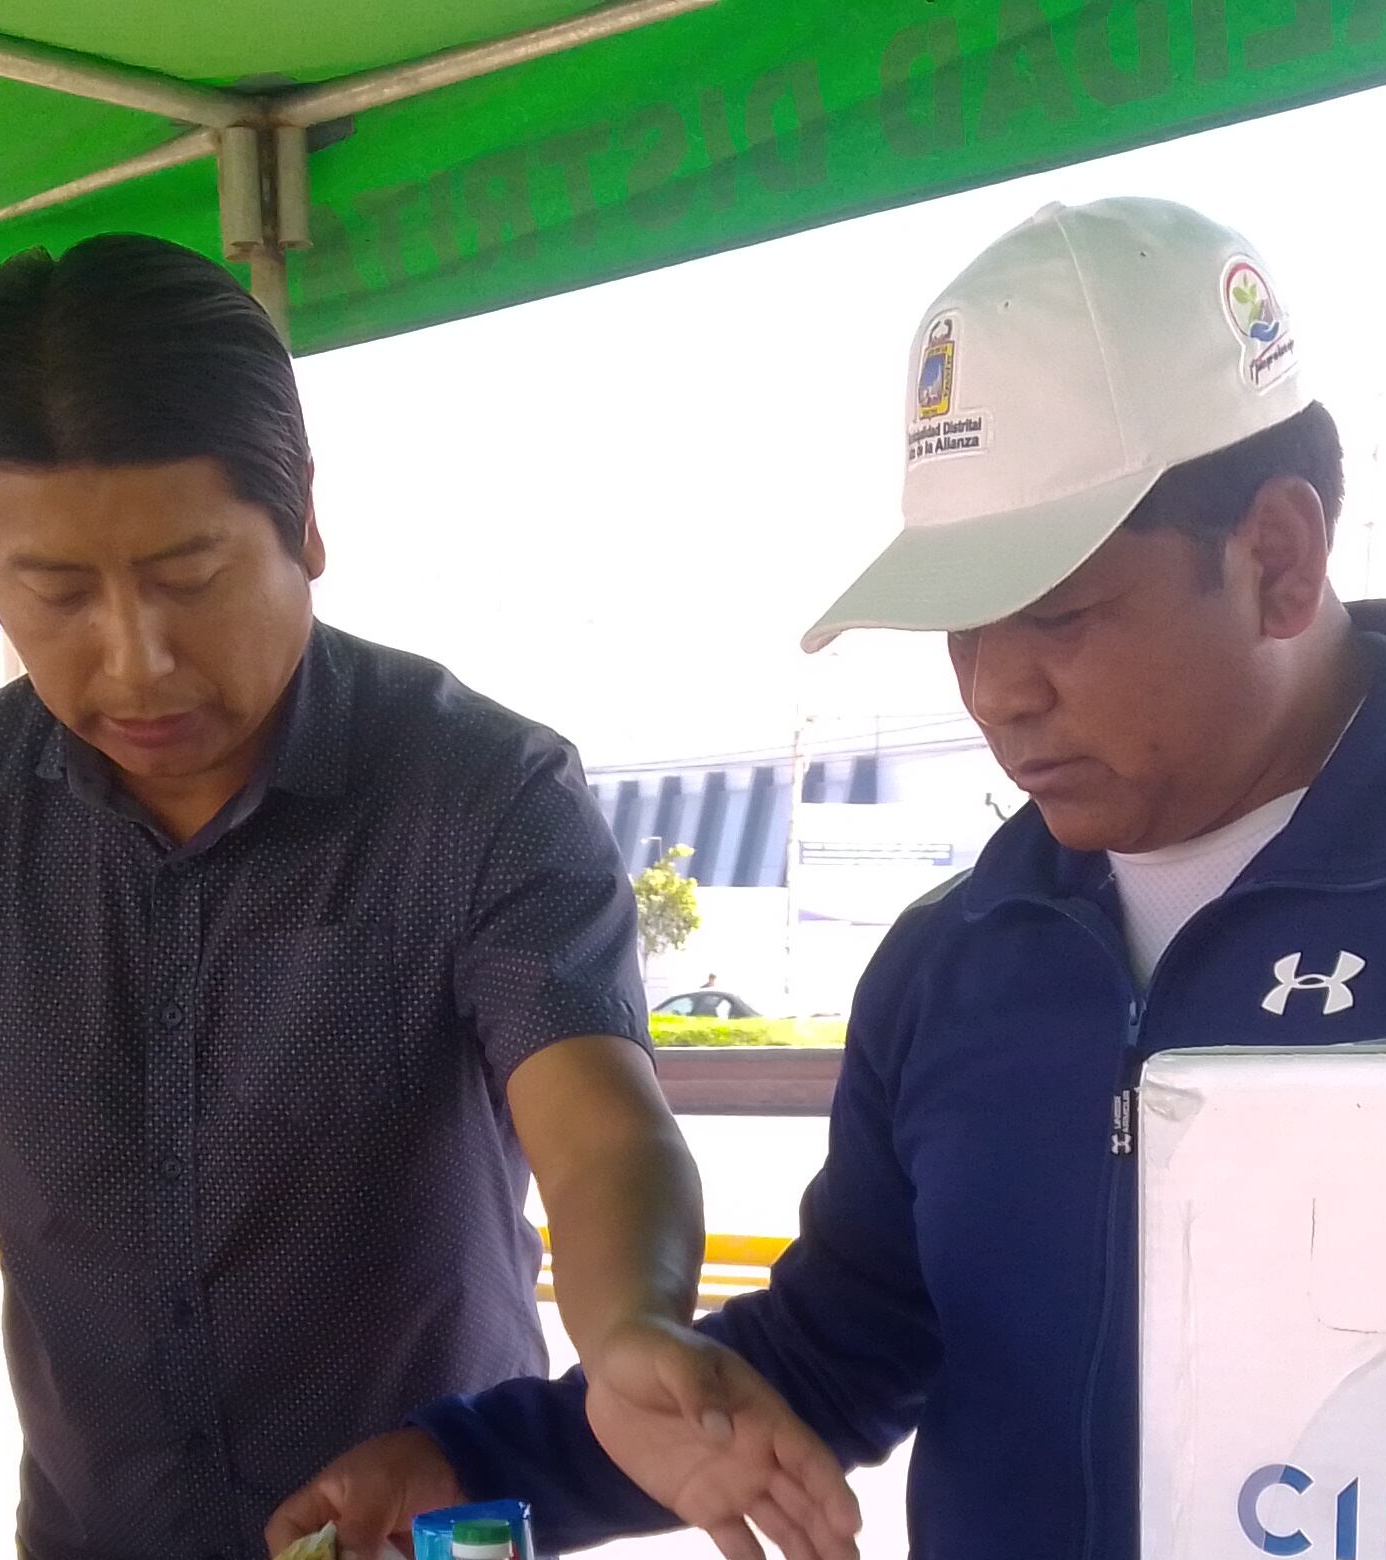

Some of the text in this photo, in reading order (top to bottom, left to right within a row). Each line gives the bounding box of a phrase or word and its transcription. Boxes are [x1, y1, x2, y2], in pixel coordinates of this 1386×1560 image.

[943, 417, 982, 435] Distrital
[935, 435, 980, 453] Alianza
[1122, 1090, 1130, 1132] ARMOUR
